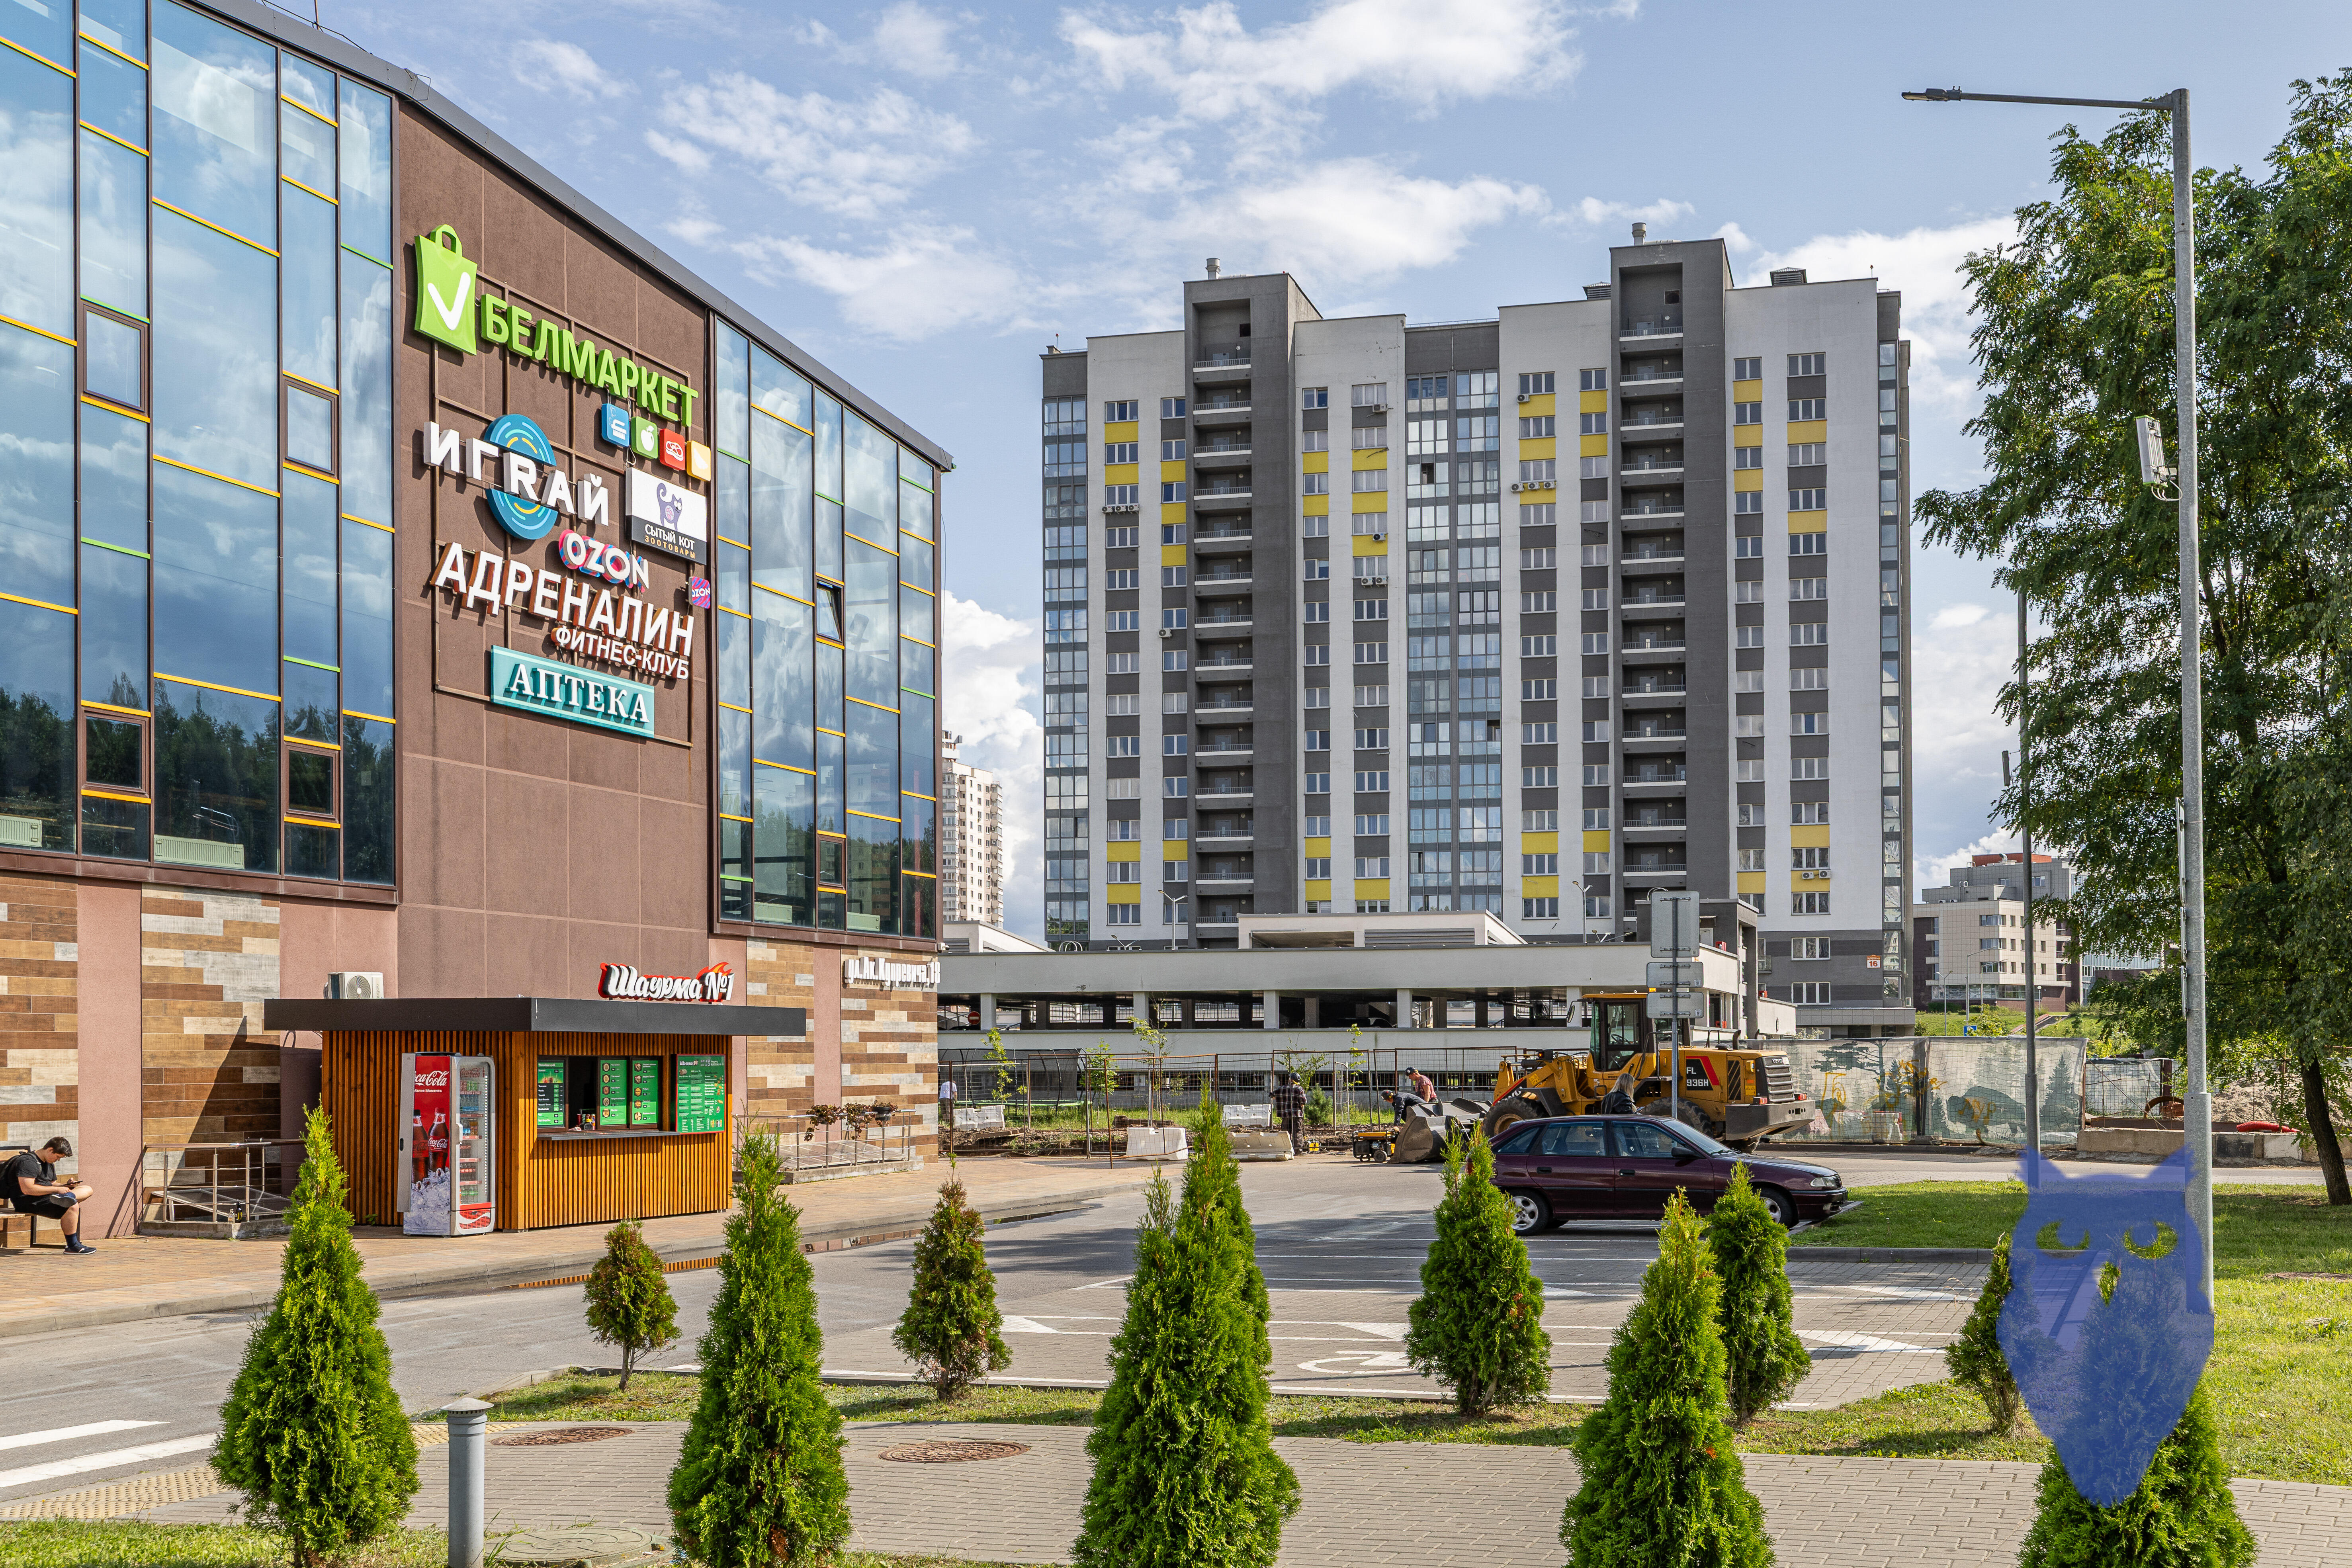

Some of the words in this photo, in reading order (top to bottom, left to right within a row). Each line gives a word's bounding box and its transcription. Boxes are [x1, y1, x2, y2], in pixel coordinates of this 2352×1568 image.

[481, 293, 699, 428] БЕЛМАРКЕТ
[645, 524, 676, 544] СЫТЫЙ
[678, 536, 695, 550] КОТ
[645, 535, 696, 559] ЗООТОВАРЫ
[562, 531, 649, 591] OZON
[432, 542, 694, 657] АДРЕНАЛИН
[553, 625, 689, 680] ФИТНЕС-КЛУБ
[508, 663, 650, 723] АПТЕКА
[607, 964, 702, 1000] Шаурма
[414, 1070, 450, 1086] ca-Cola
[428, 1137, 448, 1148] Coca-Cola
